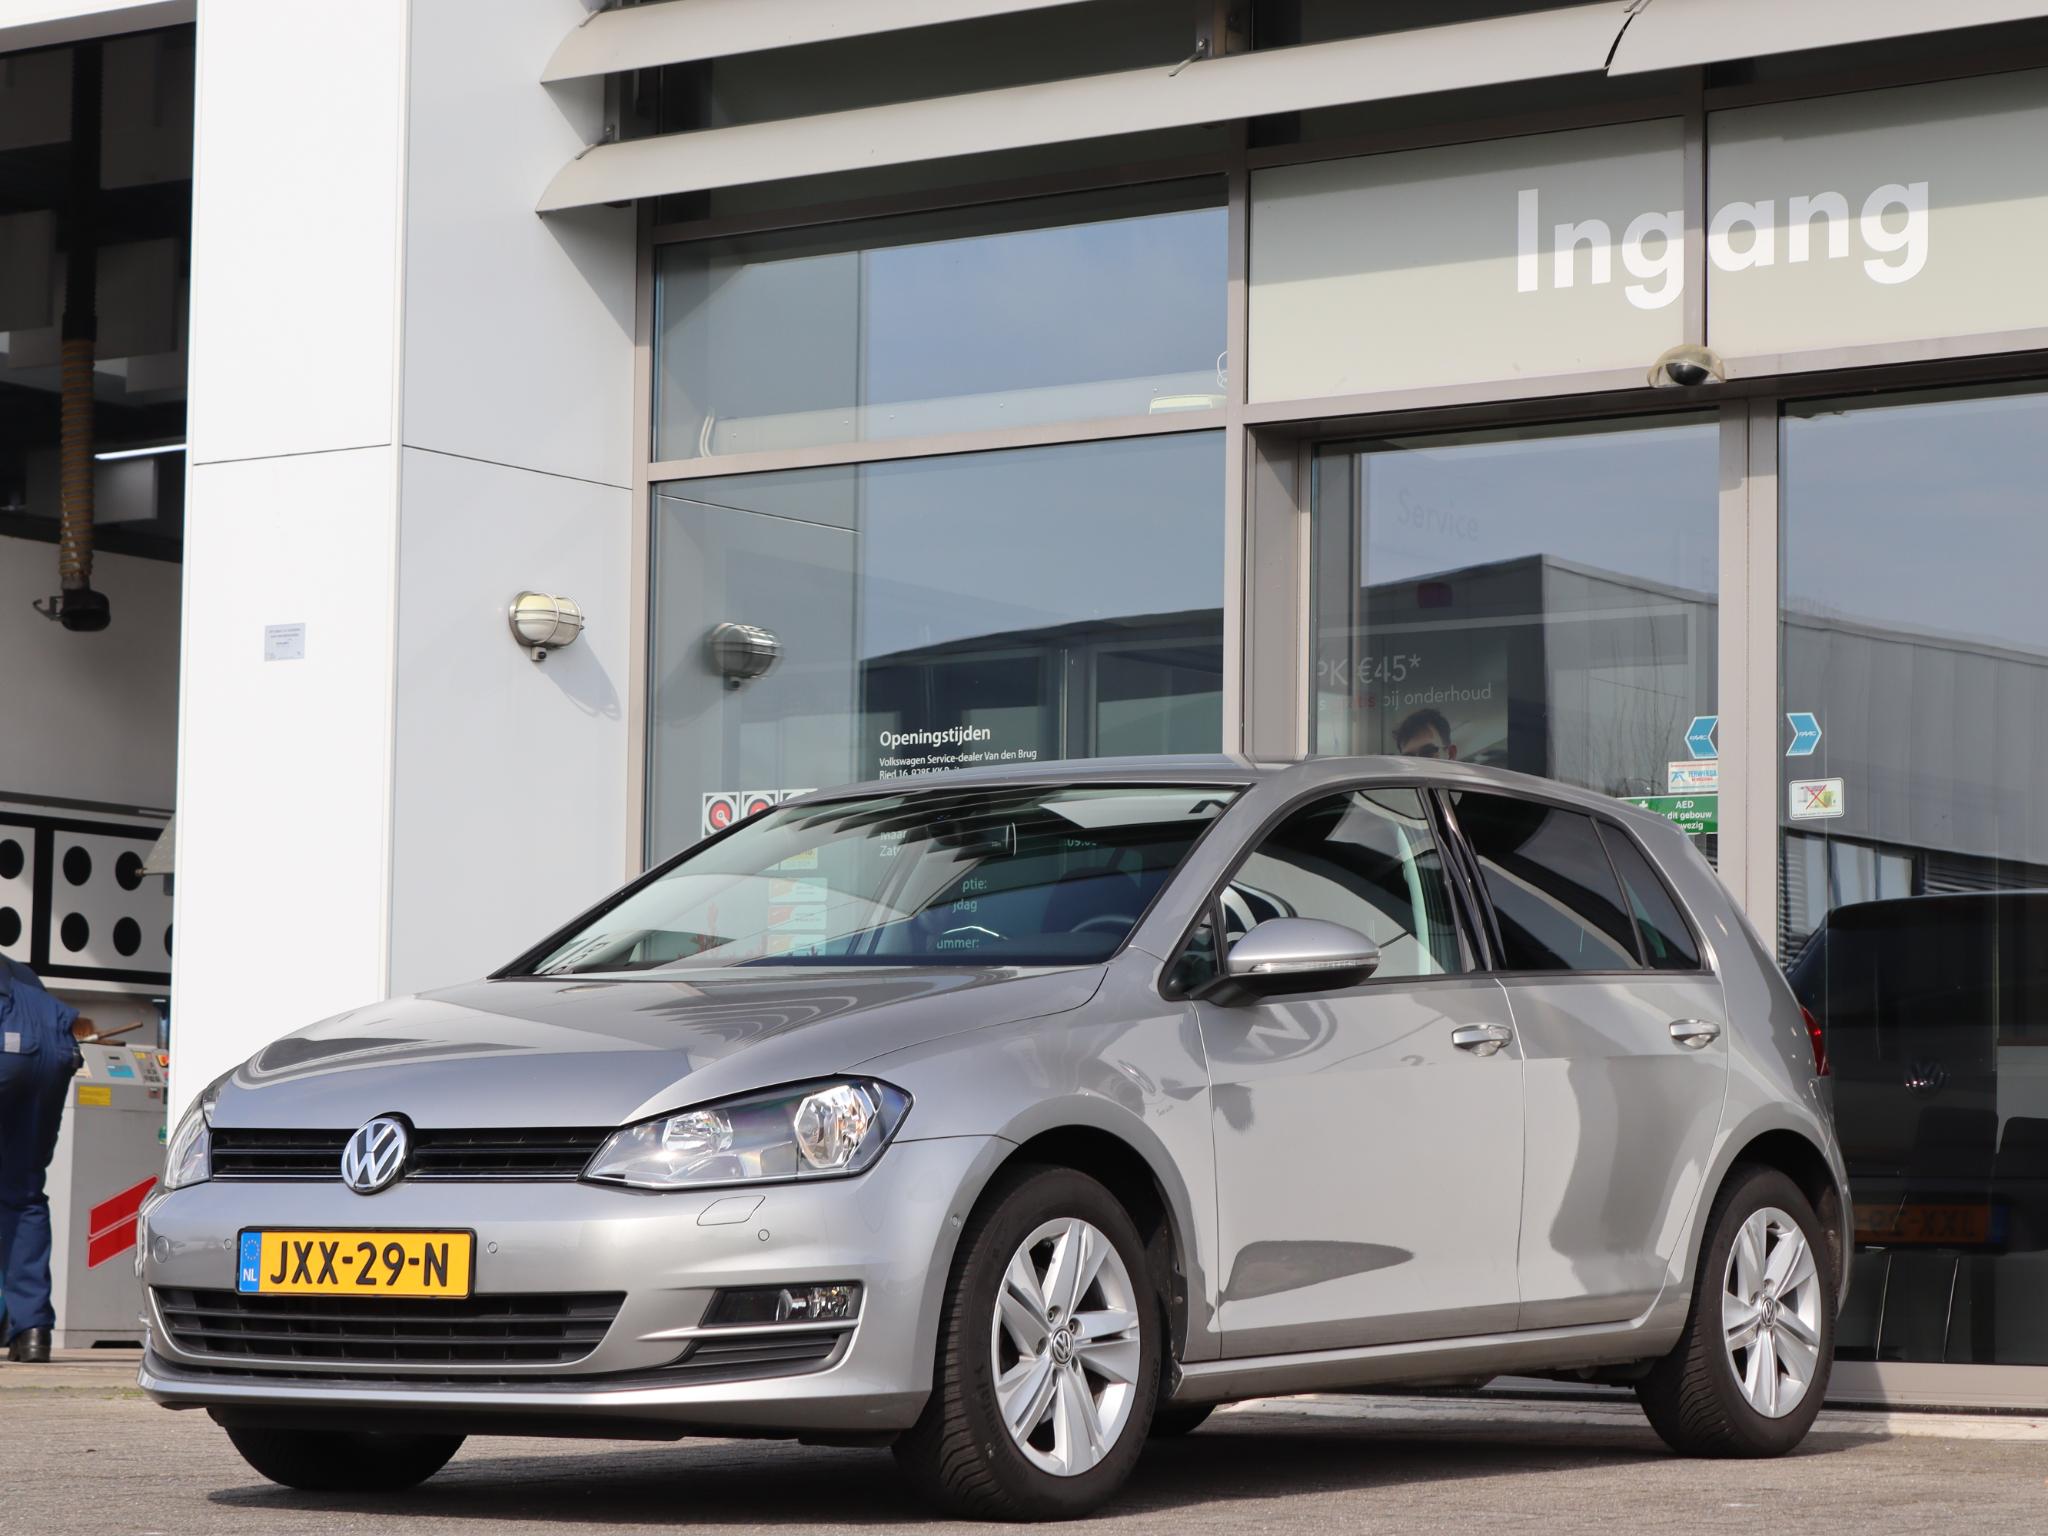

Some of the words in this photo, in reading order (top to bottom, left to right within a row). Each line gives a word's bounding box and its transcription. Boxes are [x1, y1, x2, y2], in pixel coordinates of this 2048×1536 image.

[1516, 180, 1930, 310] Ingang
[1404, 683, 1492, 705] onderhoud
[879, 725, 991, 749] Openingstijden
[879, 757, 926, 767] Volkswagen
[927, 752, 983, 764] Service-dealer
[984, 751, 999, 761] Van
[1000, 749, 1017, 760] den
[1018, 749, 1037, 761] Brug
[1675, 800, 1694, 809] AED
[1667, 811, 1678, 820] dit
[1680, 811, 1712, 821] gebouw
[242, 1267, 258, 1282] NL
[270, 1240, 450, 1288] JXX-29-N
